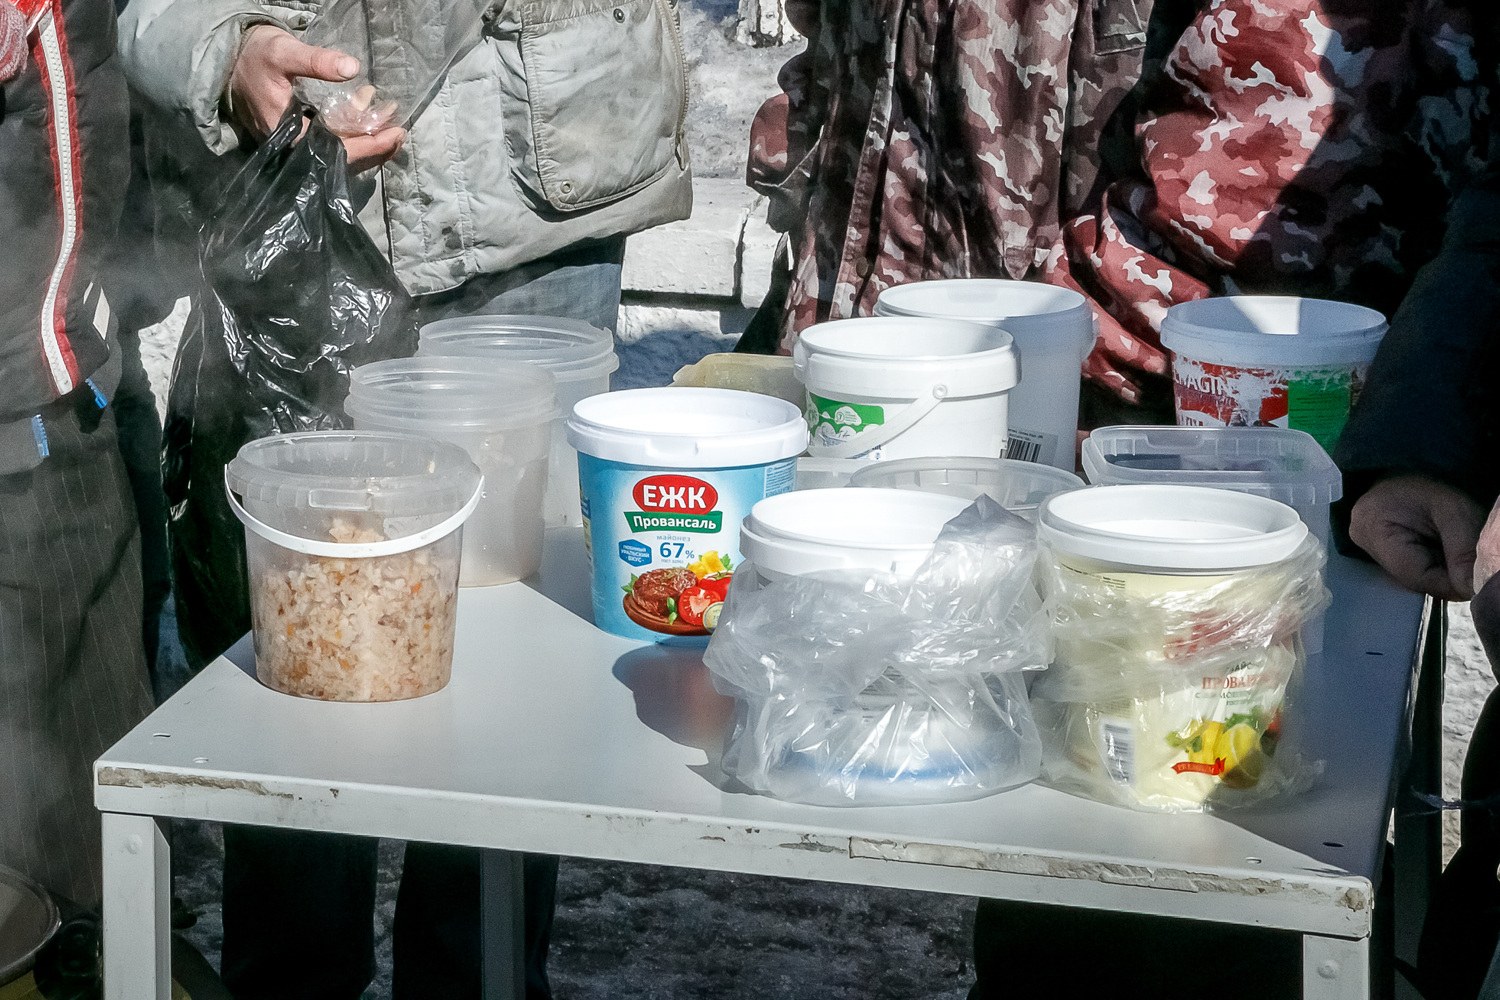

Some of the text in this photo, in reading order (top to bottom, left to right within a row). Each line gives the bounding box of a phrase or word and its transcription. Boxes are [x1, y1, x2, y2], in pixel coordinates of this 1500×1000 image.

[642, 484, 707, 509] ЕЖК
[633, 515, 717, 530] Провансаль
[657, 534, 691, 542] майонез
[659, 541, 695, 559] 67%
